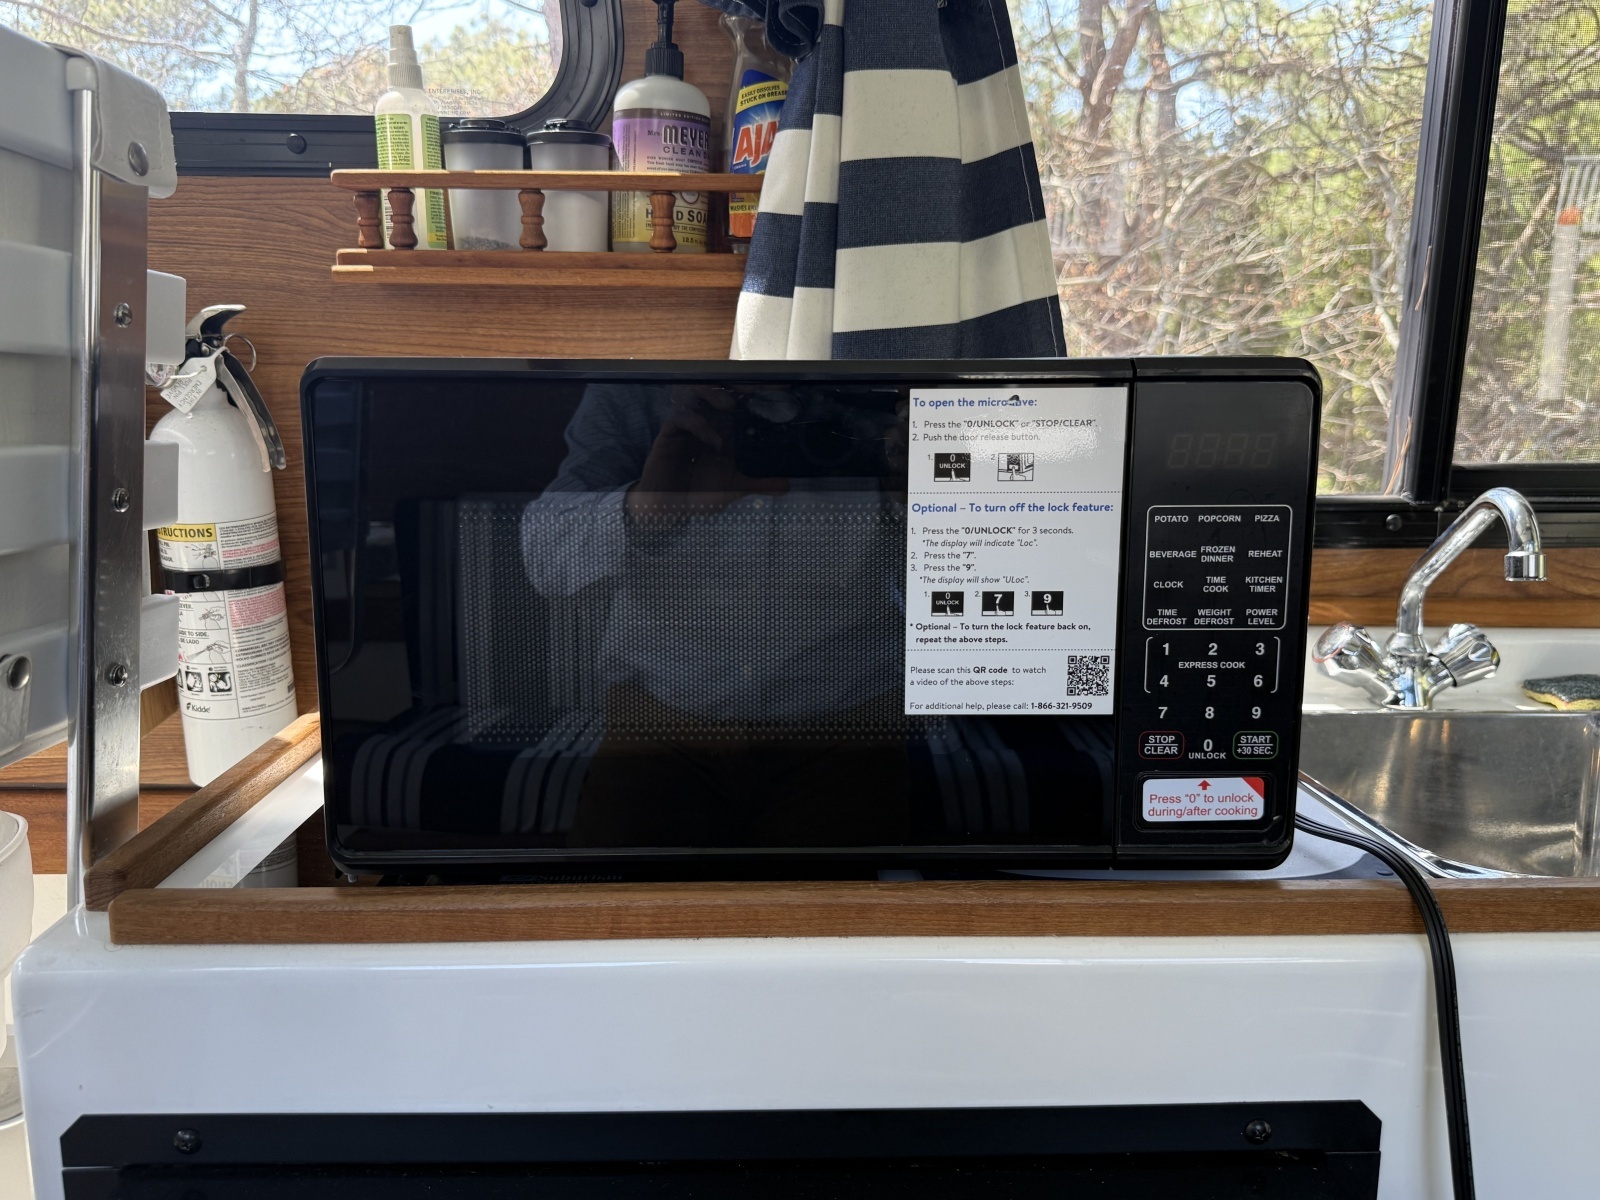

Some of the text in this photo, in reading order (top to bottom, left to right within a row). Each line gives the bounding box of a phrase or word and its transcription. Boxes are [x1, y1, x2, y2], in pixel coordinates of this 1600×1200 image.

[742, 85, 780, 99] EASILY DISSOLVES
[740, 96, 758, 106] STUCK
[662, 125, 708, 150] MEYER
[734, 120, 779, 168] AJA
[663, 146, 701, 157] CLEAN
[687, 210, 707, 224] SOA
[913, 397, 1037, 409] To open the microave:
[944, 433, 957, 441] the
[960, 433, 977, 441] door
[981, 433, 1009, 441] release
[1011, 433, 1040, 441] button.
[912, 502, 1113, 514] Optional To turn off the lock feature:
[941, 540, 967, 548] display
[938, 576, 964, 584] display
[994, 594, 1002, 603] 7
[1043, 594, 1052, 603] 9
[916, 623, 950, 632] Optional
[1163, 643, 1169, 655] 1
[1208, 643, 1218, 655] 2
[1255, 643, 1264, 655] 3
[1160, 675, 1168, 687] 4
[1207, 675, 1216, 687] 5
[1254, 675, 1263, 687] 6
[192, 704, 210, 713] Kidde
[966, 702, 984, 710] help,
[987, 702, 1011, 710] please
[1158, 707, 1168, 719] 7
[1205, 707, 1214, 719] 8
[1252, 707, 1261, 719] 9
[1203, 739, 1213, 751] 0
[1150, 794, 1181, 803] Press
[1204, 794, 1214, 802] to
[1218, 793, 1253, 802] unlock
[1148, 806, 1257, 818] during/after cooking
